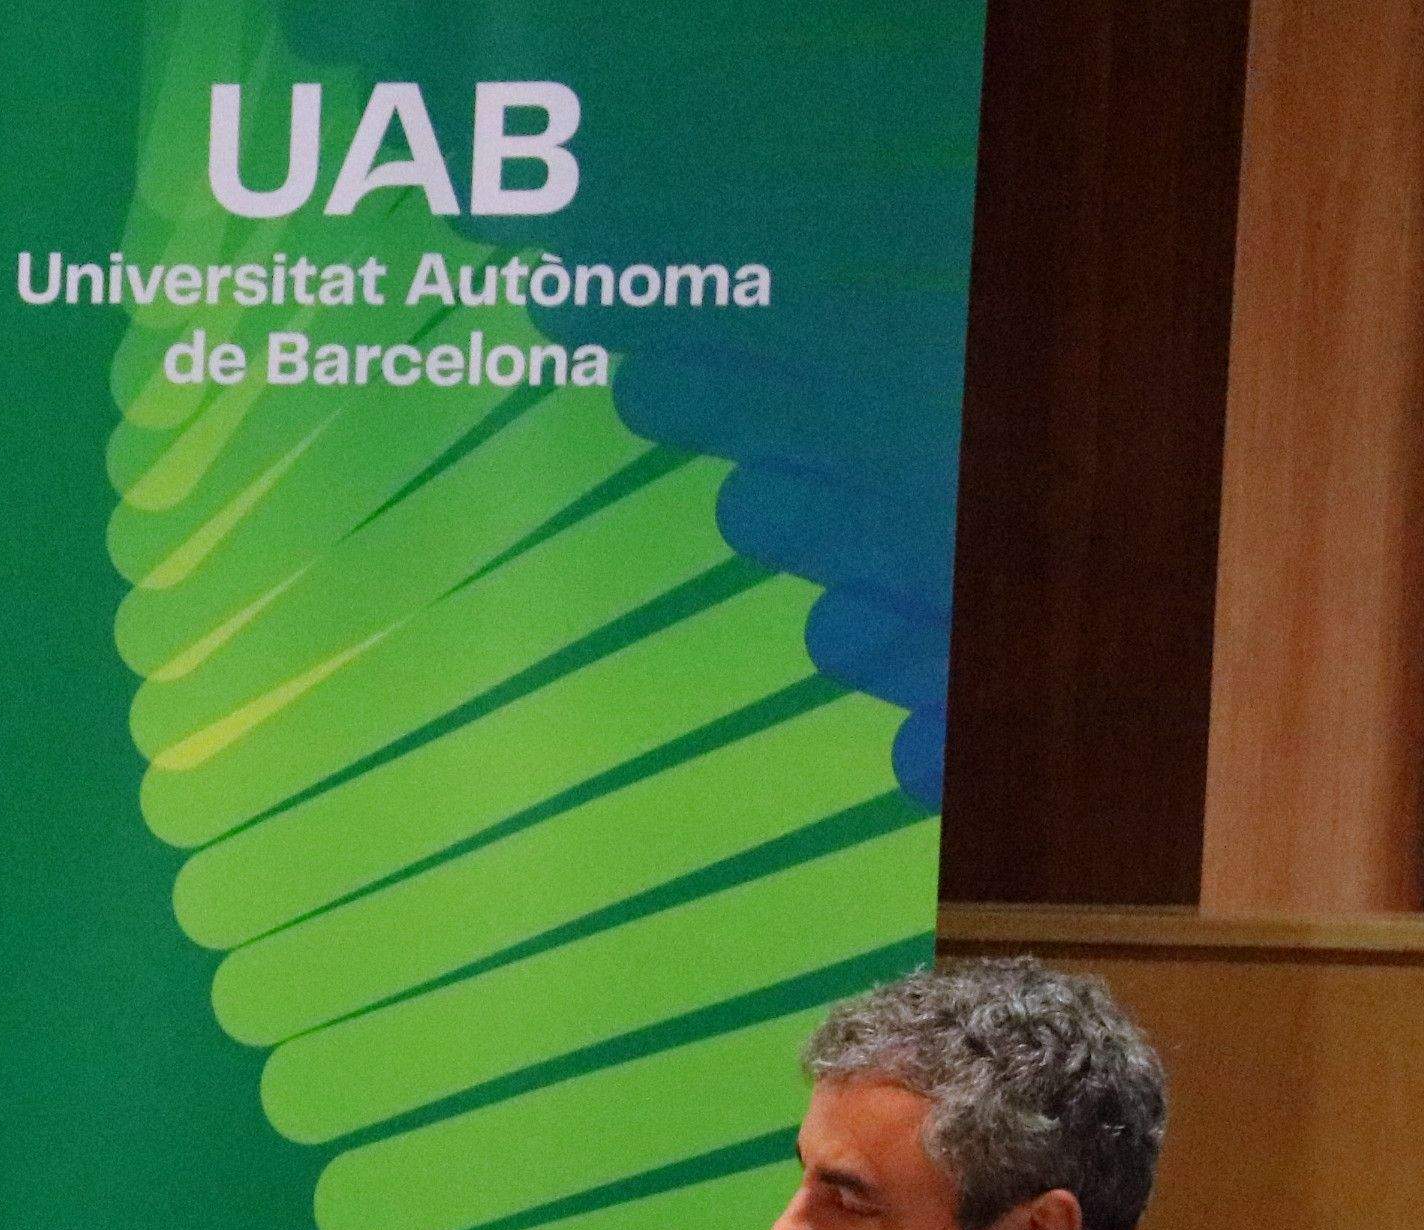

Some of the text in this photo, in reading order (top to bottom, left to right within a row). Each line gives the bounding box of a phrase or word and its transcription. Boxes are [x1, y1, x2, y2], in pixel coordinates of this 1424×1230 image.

[207, 81, 581, 218] UAB
[17, 251, 771, 306] Universitat Autònoma
[164, 329, 608, 386] de Barcelona
